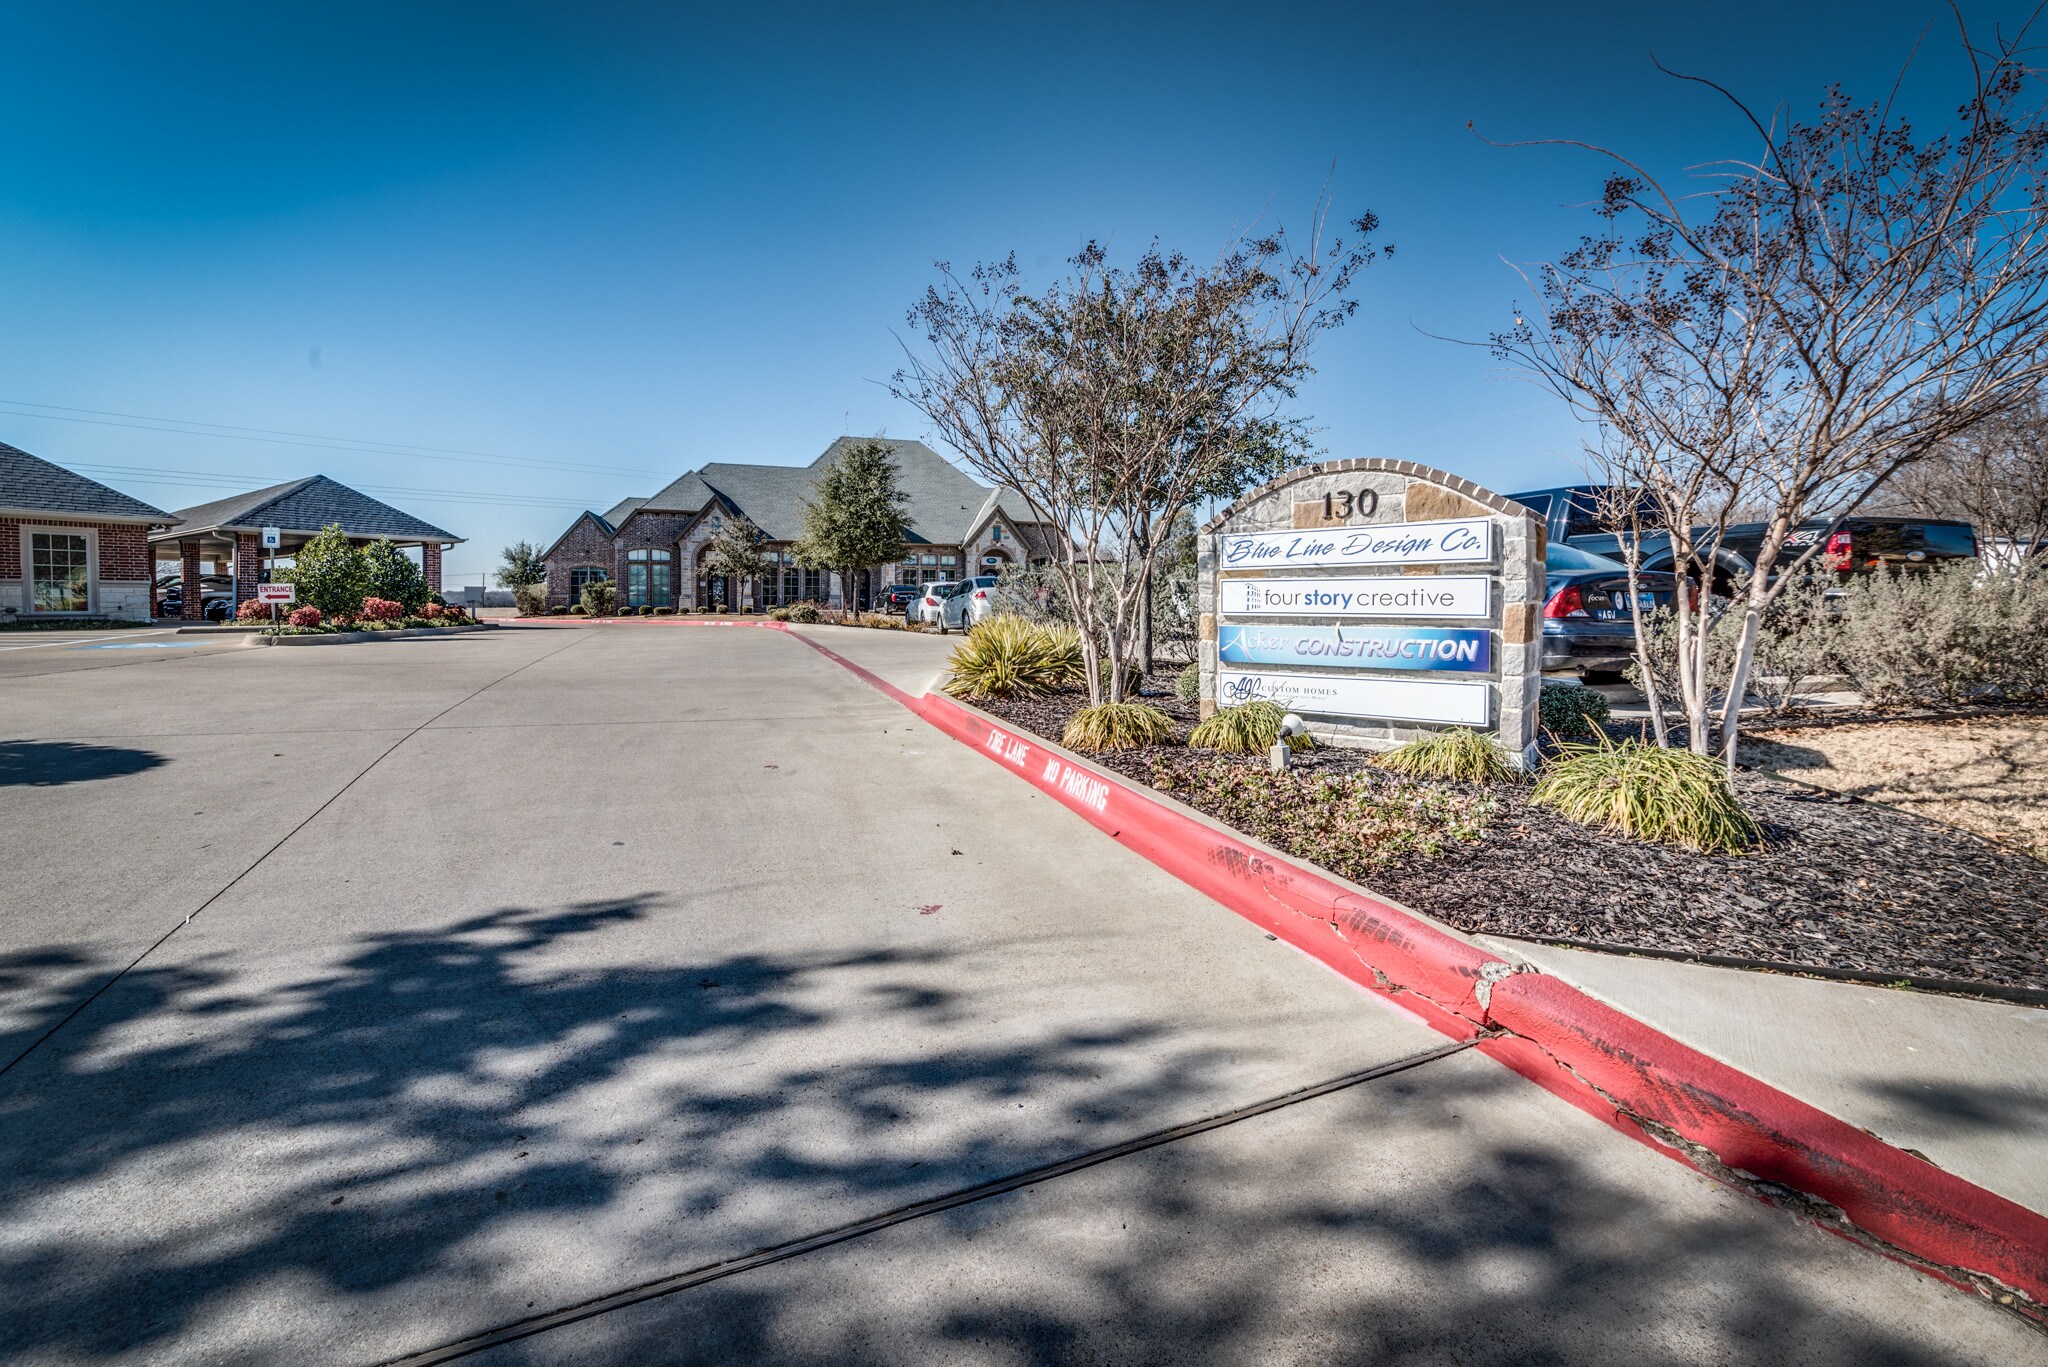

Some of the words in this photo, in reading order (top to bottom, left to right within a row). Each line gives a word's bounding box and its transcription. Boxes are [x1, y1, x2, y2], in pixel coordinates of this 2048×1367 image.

[1321, 487, 1380, 521] 130
[1226, 539, 1283, 564] Blue
[1286, 537, 1336, 560] Line
[1341, 532, 1433, 556] Design
[1440, 527, 1481, 551] Co.
[259, 585, 293, 593] ENTRANCE
[1264, 589, 1302, 607] four
[1304, 590, 1353, 609] story
[1356, 588, 1455, 607] creative
[1221, 627, 1289, 662] Acker
[1294, 637, 1480, 662] CONSTRUCTION
[1261, 685, 1300, 694] CUSTOM
[1303, 687, 1338, 696] HOMES
[985, 729, 1007, 754] FIRE
[1003, 738, 1030, 767] LANE
[1042, 758, 1061, 785] NO
[1059, 766, 1109, 811] PARKING
